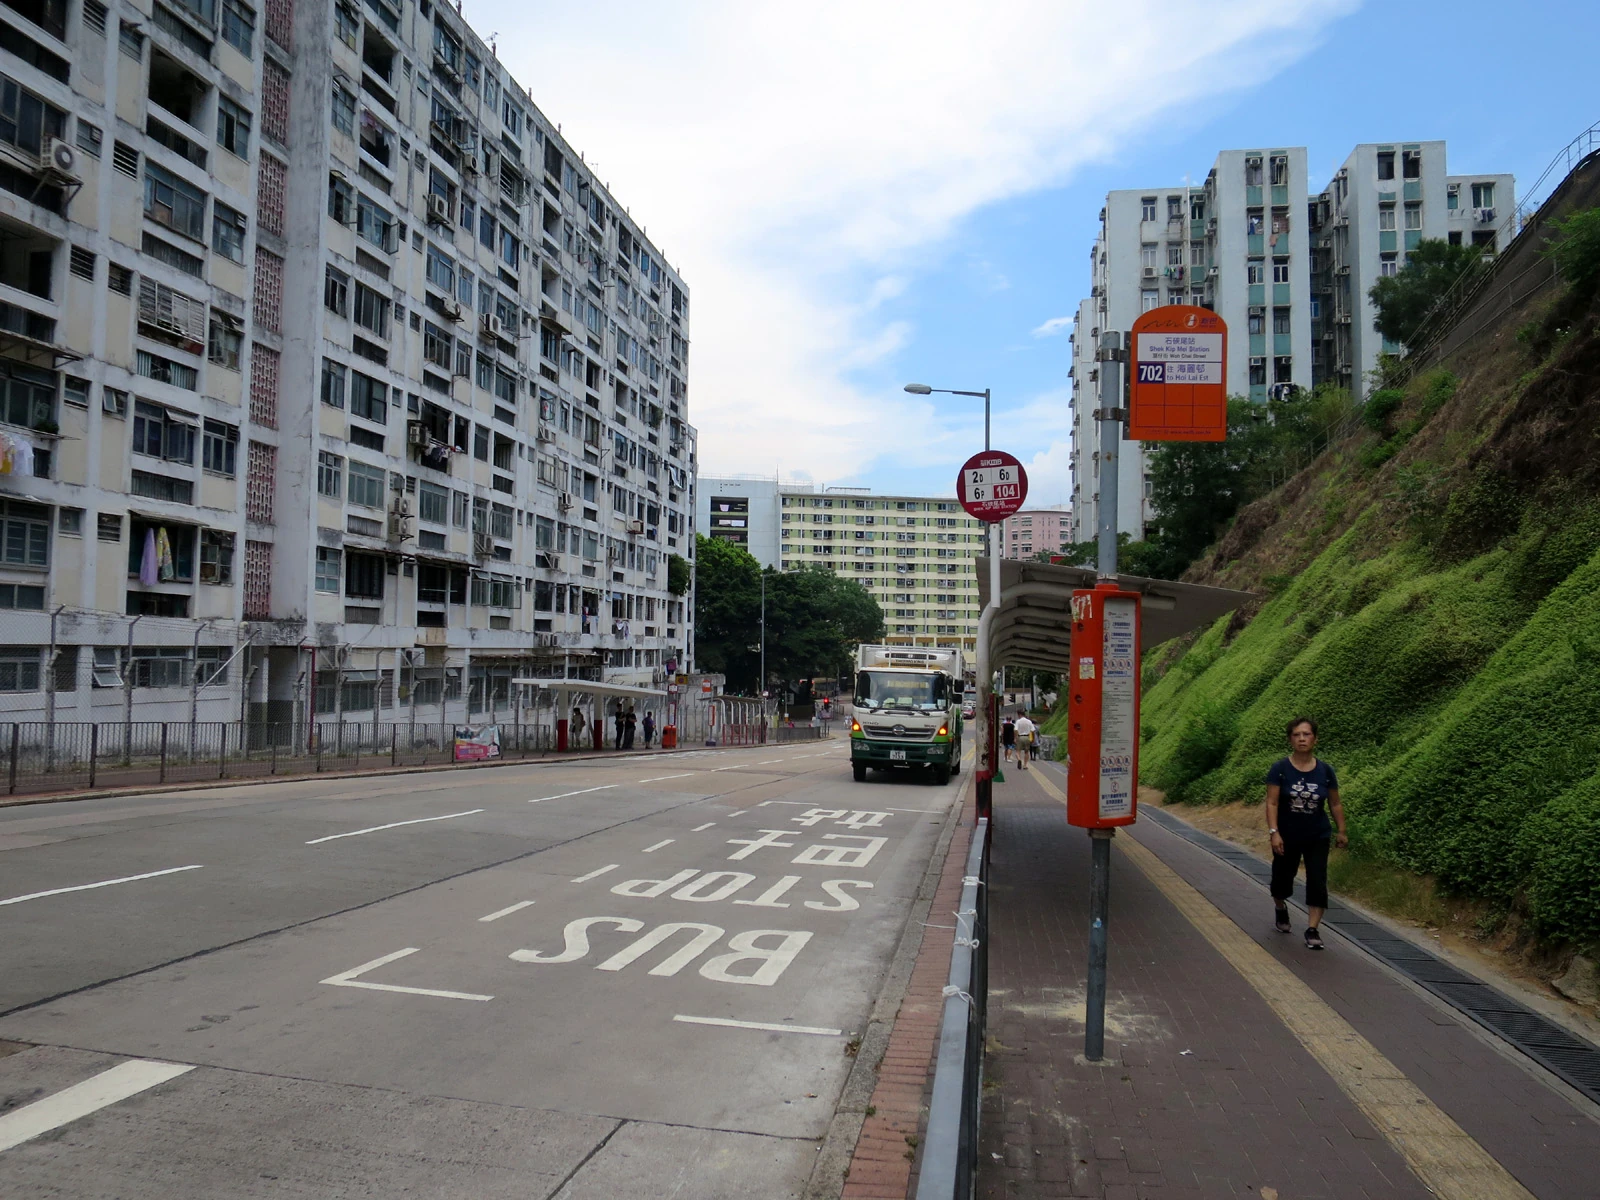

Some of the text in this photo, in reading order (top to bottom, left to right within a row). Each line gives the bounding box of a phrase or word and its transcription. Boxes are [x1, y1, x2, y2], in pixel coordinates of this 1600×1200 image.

[1140, 365, 1163, 381] 702
[1167, 365, 1174, 373] 往
[972, 471, 984, 483] 2D
[999, 469, 1010, 480] 6D
[974, 488, 985, 499] 6P
[997, 485, 1015, 497] 104
[791, 807, 895, 830] 站
[726, 829, 889, 868] 巴士
[609, 867, 875, 912] STOP
[507, 915, 815, 986] BUS
